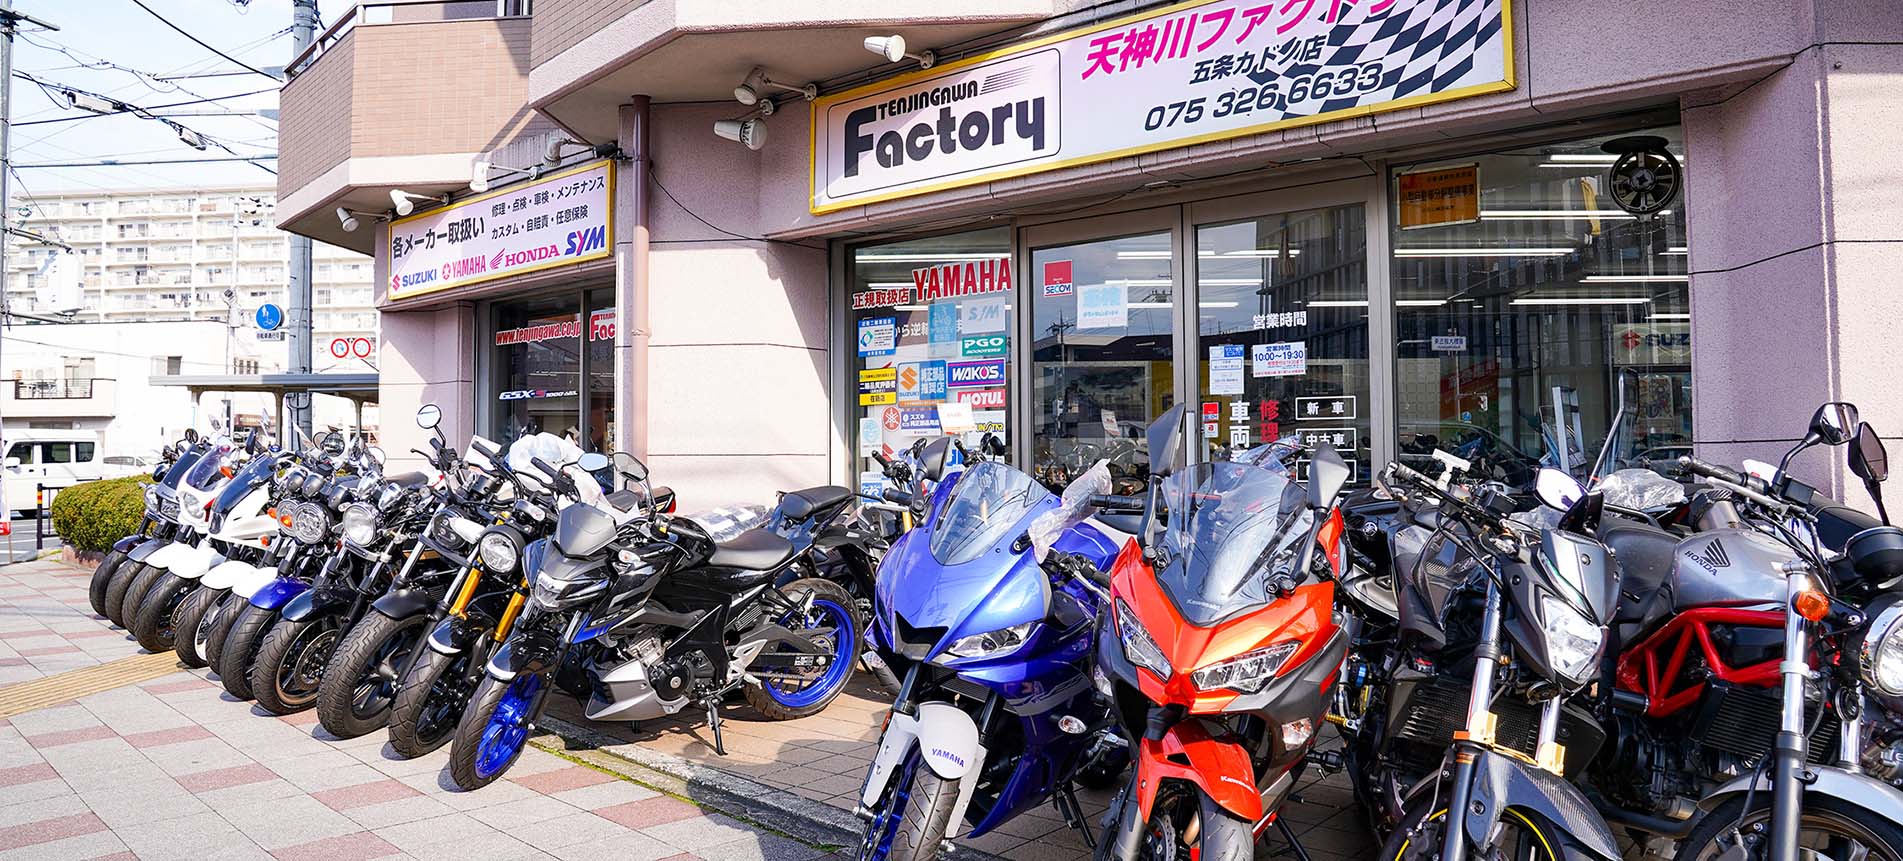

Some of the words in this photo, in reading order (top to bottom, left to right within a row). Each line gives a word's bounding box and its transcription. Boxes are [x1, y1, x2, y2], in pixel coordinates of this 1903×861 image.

[1189, 35, 1327, 84] 五条カドノ店
[877, 80, 978, 120] TENJINGAWA
[1144, 96, 1207, 131] 075
[1213, 83, 1279, 118] 326
[1287, 63, 1383, 104] 6633
[844, 96, 1045, 178] Factory
[392, 217, 485, 260] 各メーカー取扱い
[402, 268, 437, 287] SUZUKI
[452, 255, 486, 278] YAMAHA
[504, 244, 560, 267] HONDA
[564, 224, 606, 256] SYM
[913, 258, 1012, 300] YAMAHA
[1046, 284, 1071, 294] SECOM
[853, 288, 910, 308] 正規取扱店
[1252, 311, 1307, 330] 営業時間
[964, 337, 1004, 349] PGO
[960, 392, 1004, 405] MOTUL
[1260, 400, 1279, 443] 修理
[1306, 433, 1345, 447] 中古車
[1684, 549, 1718, 577] HONDA
[932, 748, 964, 768] YAMAHA
